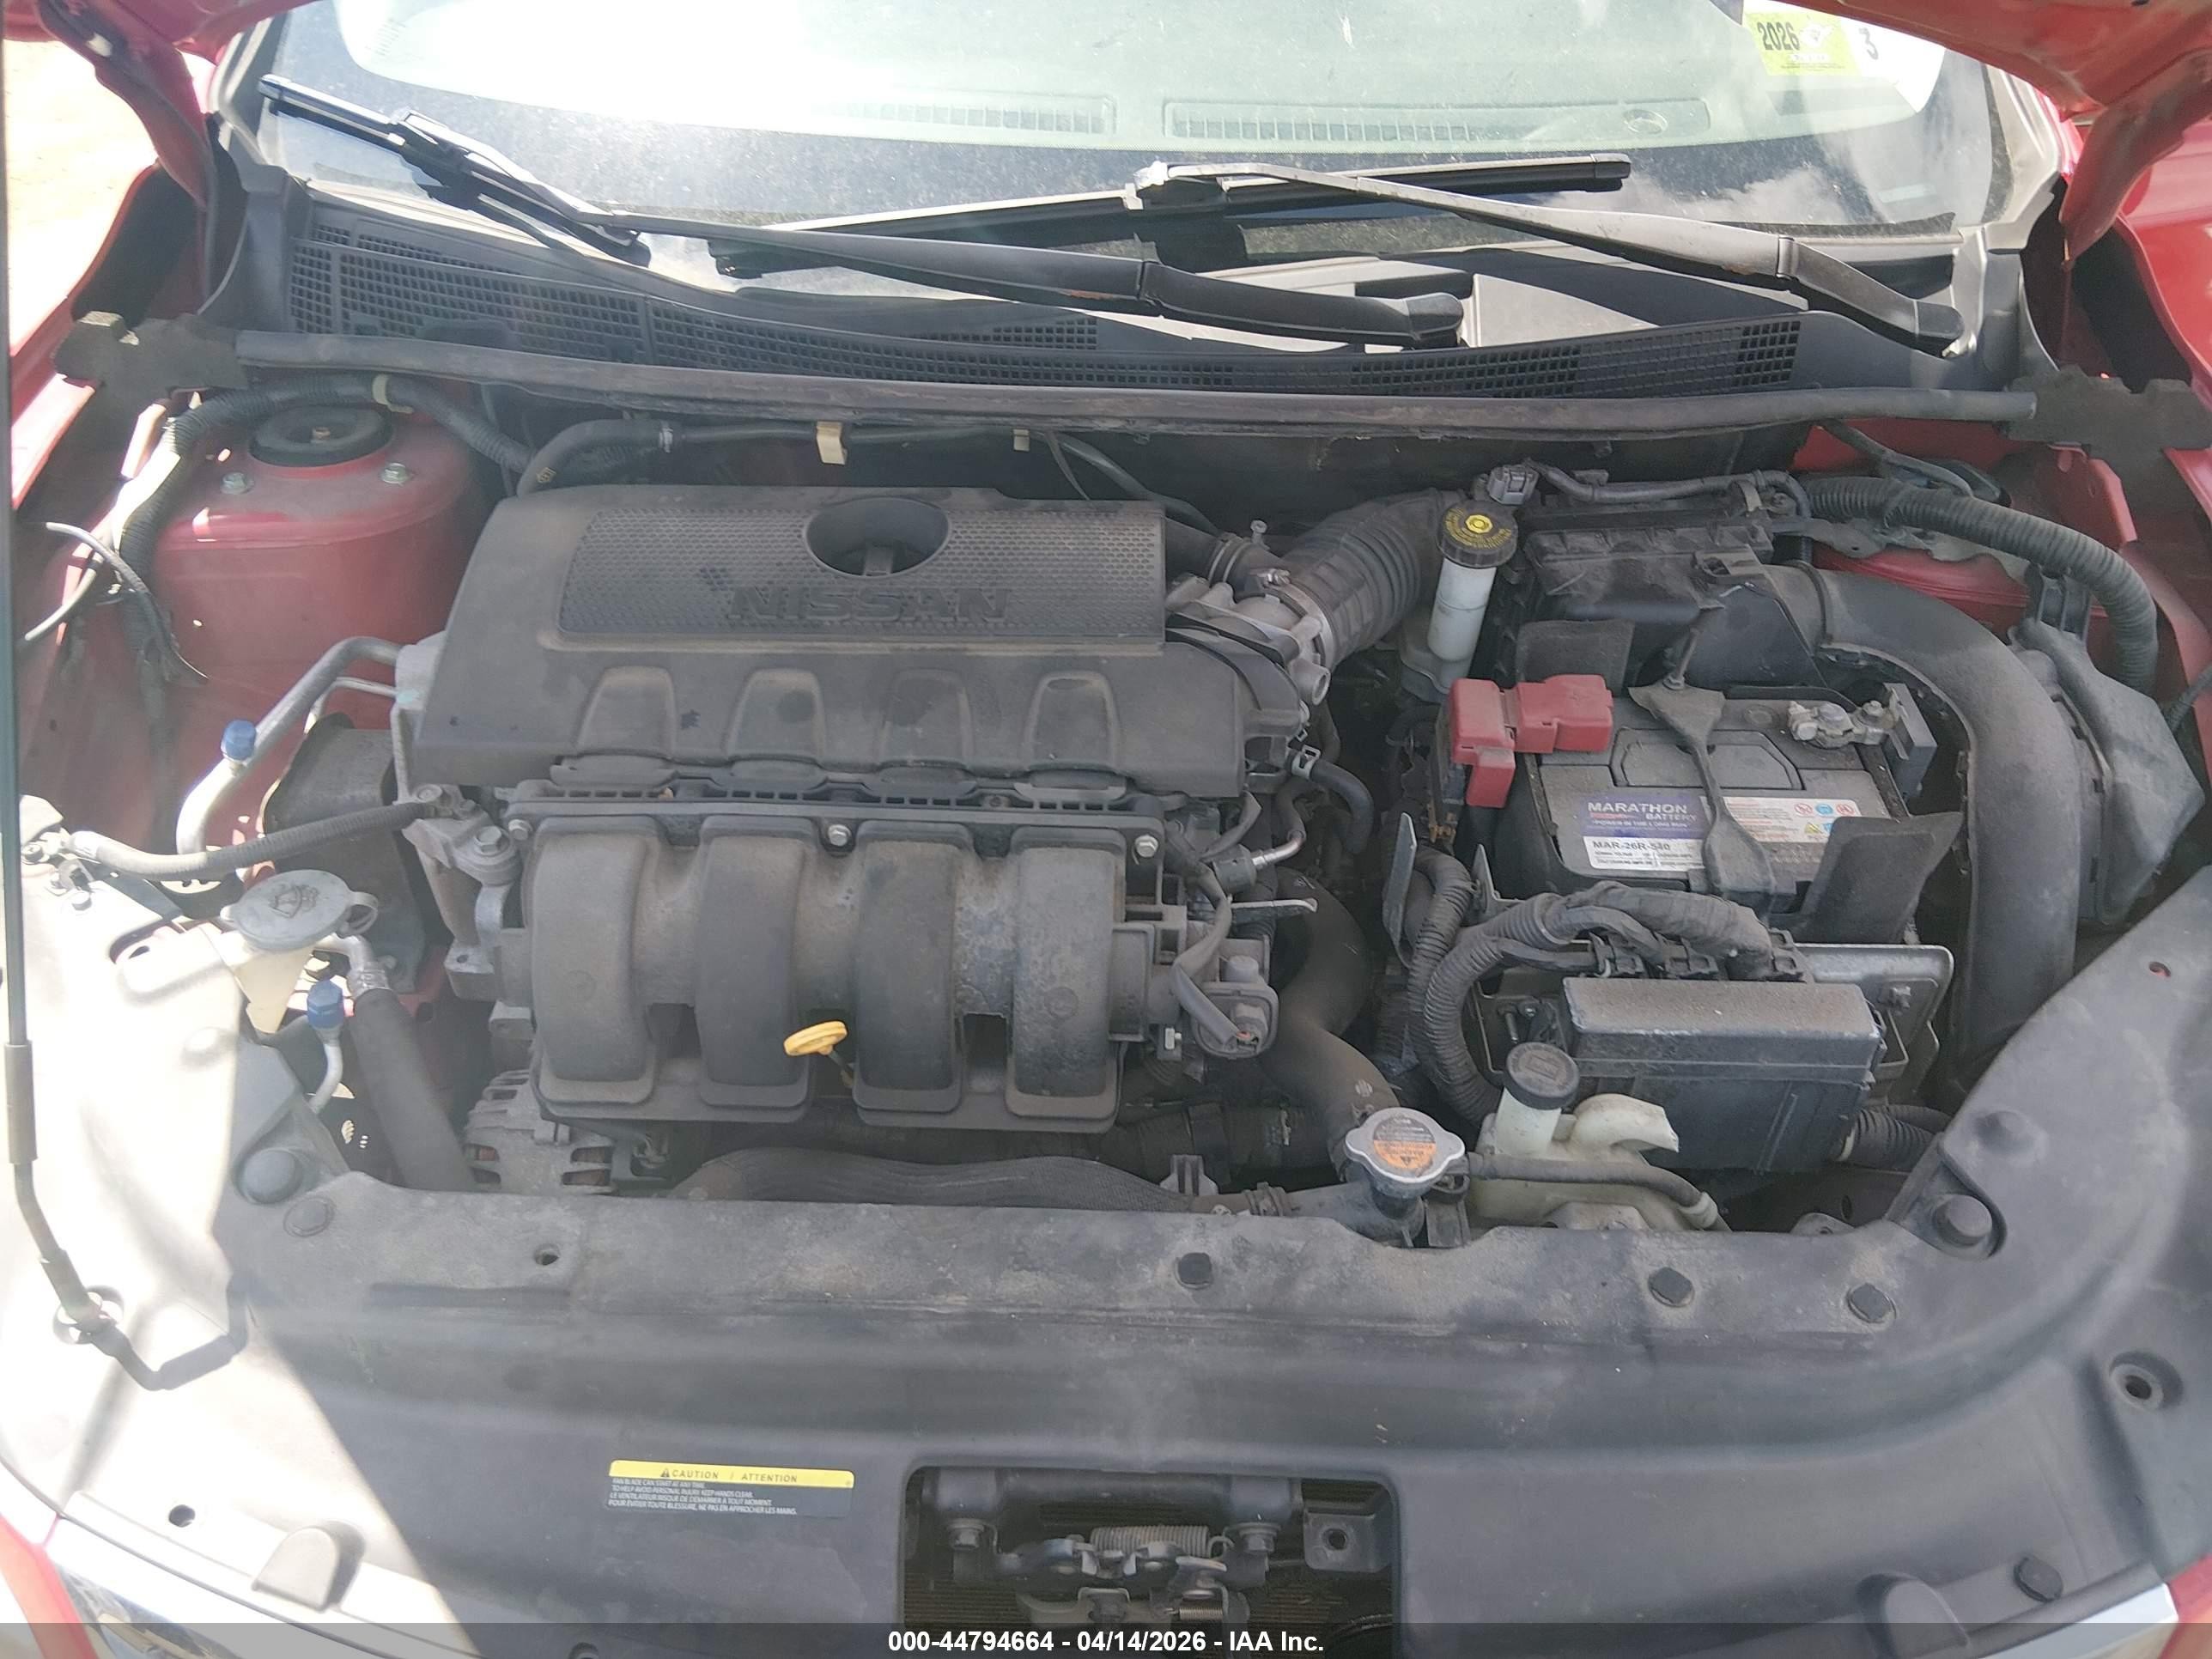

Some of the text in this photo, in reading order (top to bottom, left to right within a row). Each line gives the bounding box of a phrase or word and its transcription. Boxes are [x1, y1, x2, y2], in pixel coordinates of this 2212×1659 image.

[1757, 21, 1879, 60] 2026 3
[727, 586, 1012, 623] NISSAN
[1587, 802, 1687, 814] MARATHON
[1644, 812, 1698, 822] BATTERY
[672, 1469, 719, 1480] CAUTION
[741, 1473, 798, 1483] ATTENTION
